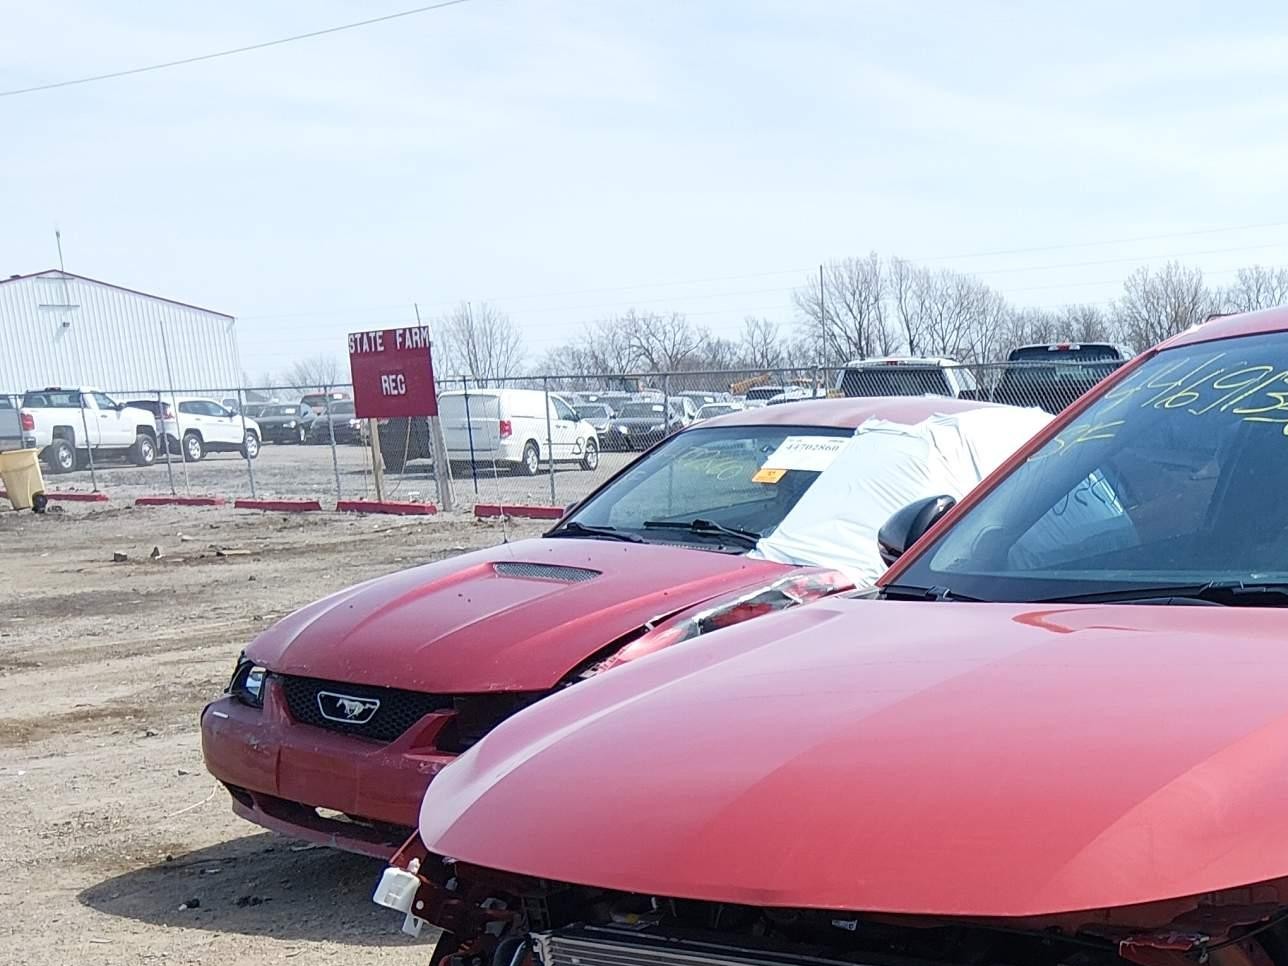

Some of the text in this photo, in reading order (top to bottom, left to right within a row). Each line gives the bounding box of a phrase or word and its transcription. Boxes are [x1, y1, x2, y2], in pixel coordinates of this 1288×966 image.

[348, 327, 430, 353] STATE FARM
[381, 374, 406, 396] REG
